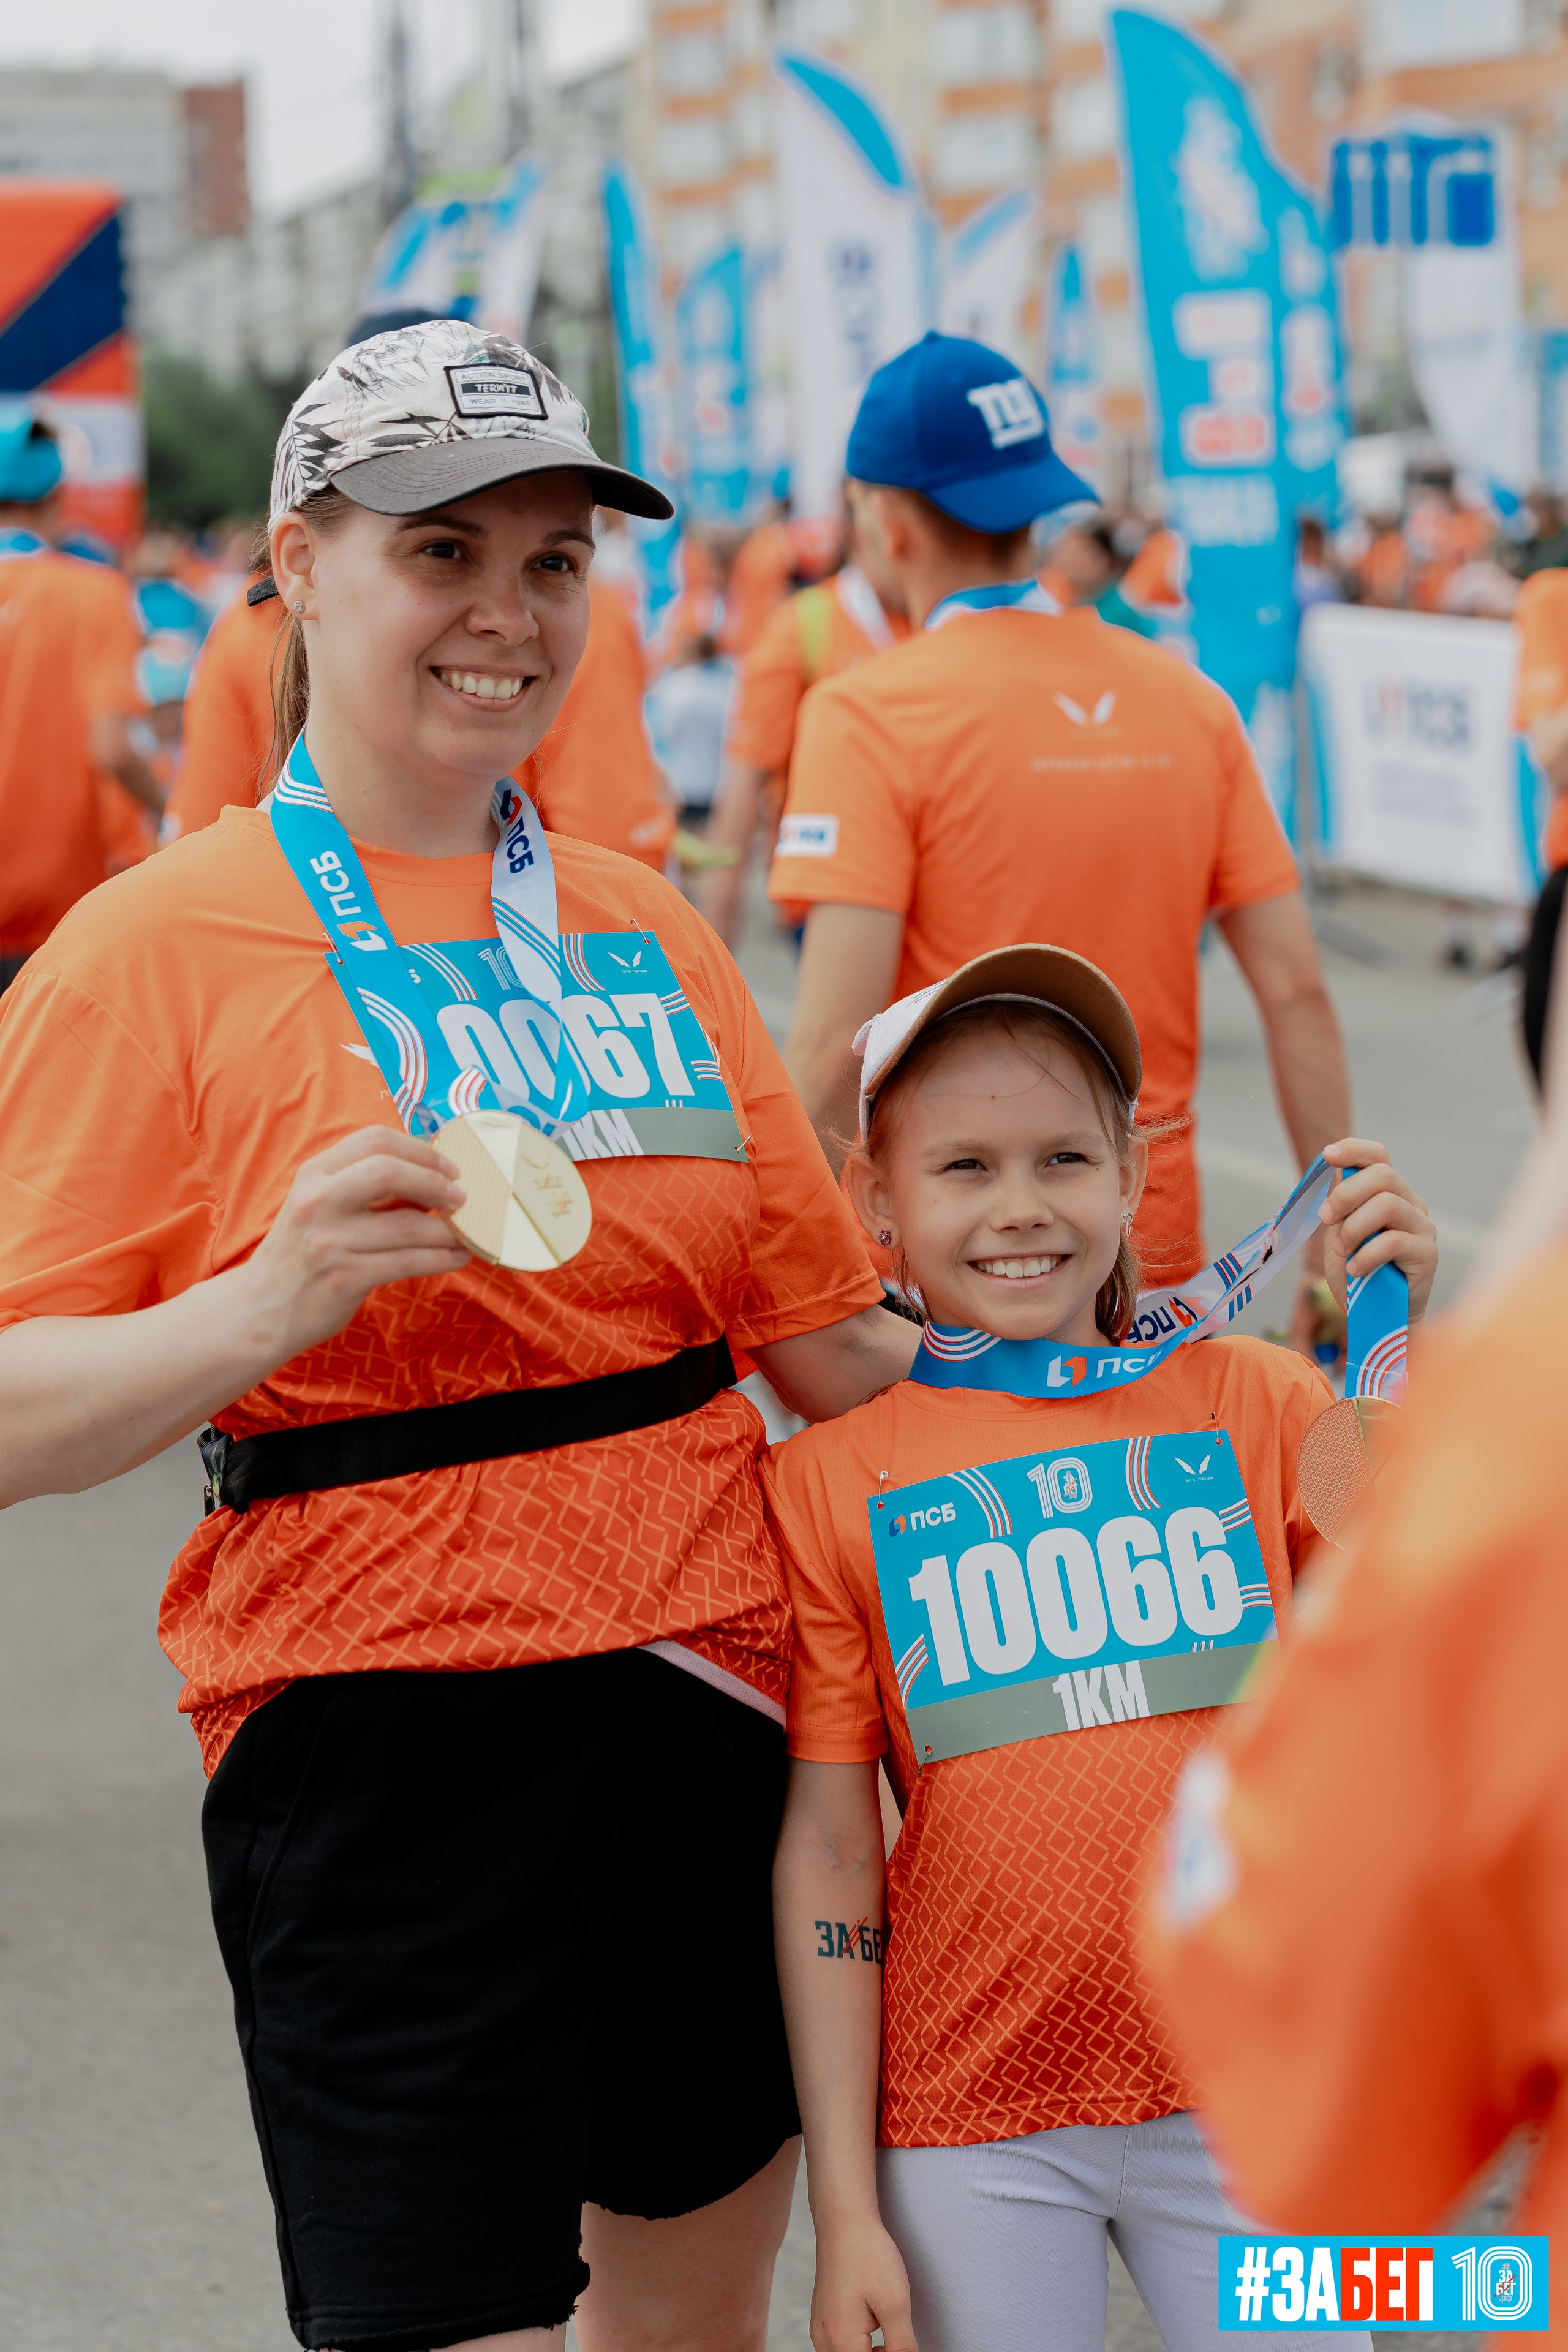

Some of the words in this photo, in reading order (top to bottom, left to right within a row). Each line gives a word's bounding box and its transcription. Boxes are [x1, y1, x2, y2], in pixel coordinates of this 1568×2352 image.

[498, 372, 526, 382] SPORT
[506, 815, 535, 874] ПСБ
[309, 850, 363, 917] ПСБ
[436, 993, 696, 1101] 0067
[910, 1502, 957, 1531] ПСБ
[1026, 1457, 1093, 1519] 10
[908, 1506, 1244, 1686] 10066
